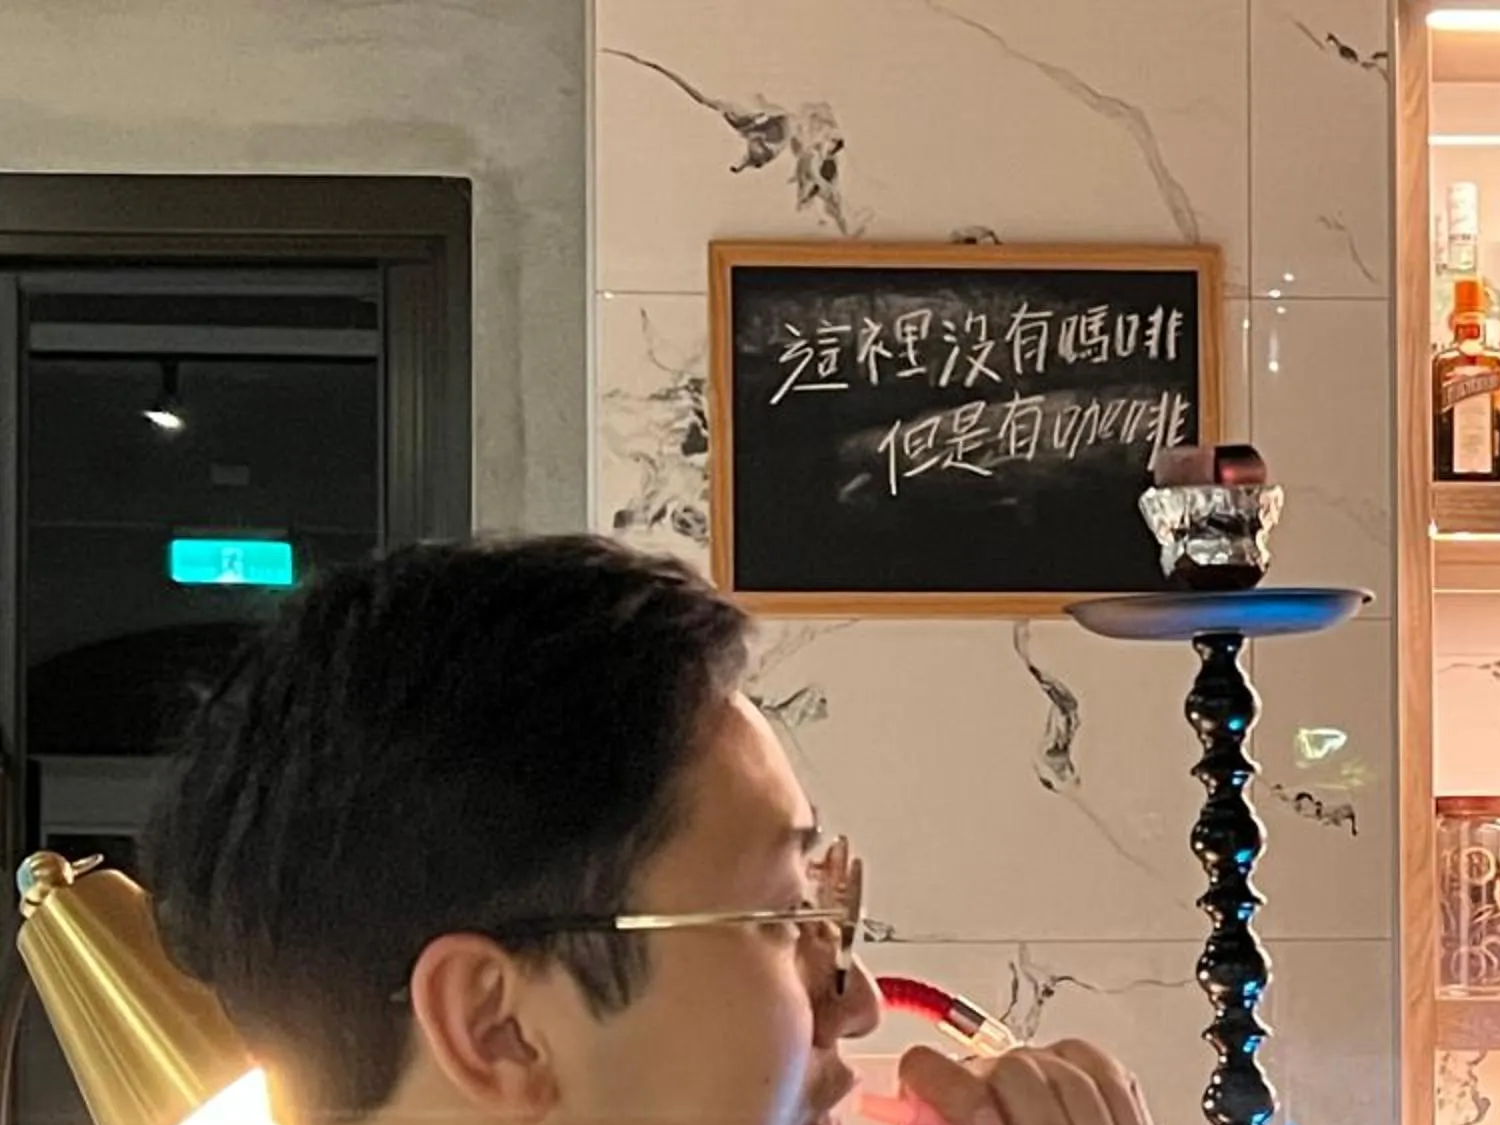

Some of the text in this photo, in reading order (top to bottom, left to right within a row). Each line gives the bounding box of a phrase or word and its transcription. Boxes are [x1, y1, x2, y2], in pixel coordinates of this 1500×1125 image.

[878, 391, 1190, 497] 但是有咖啡
